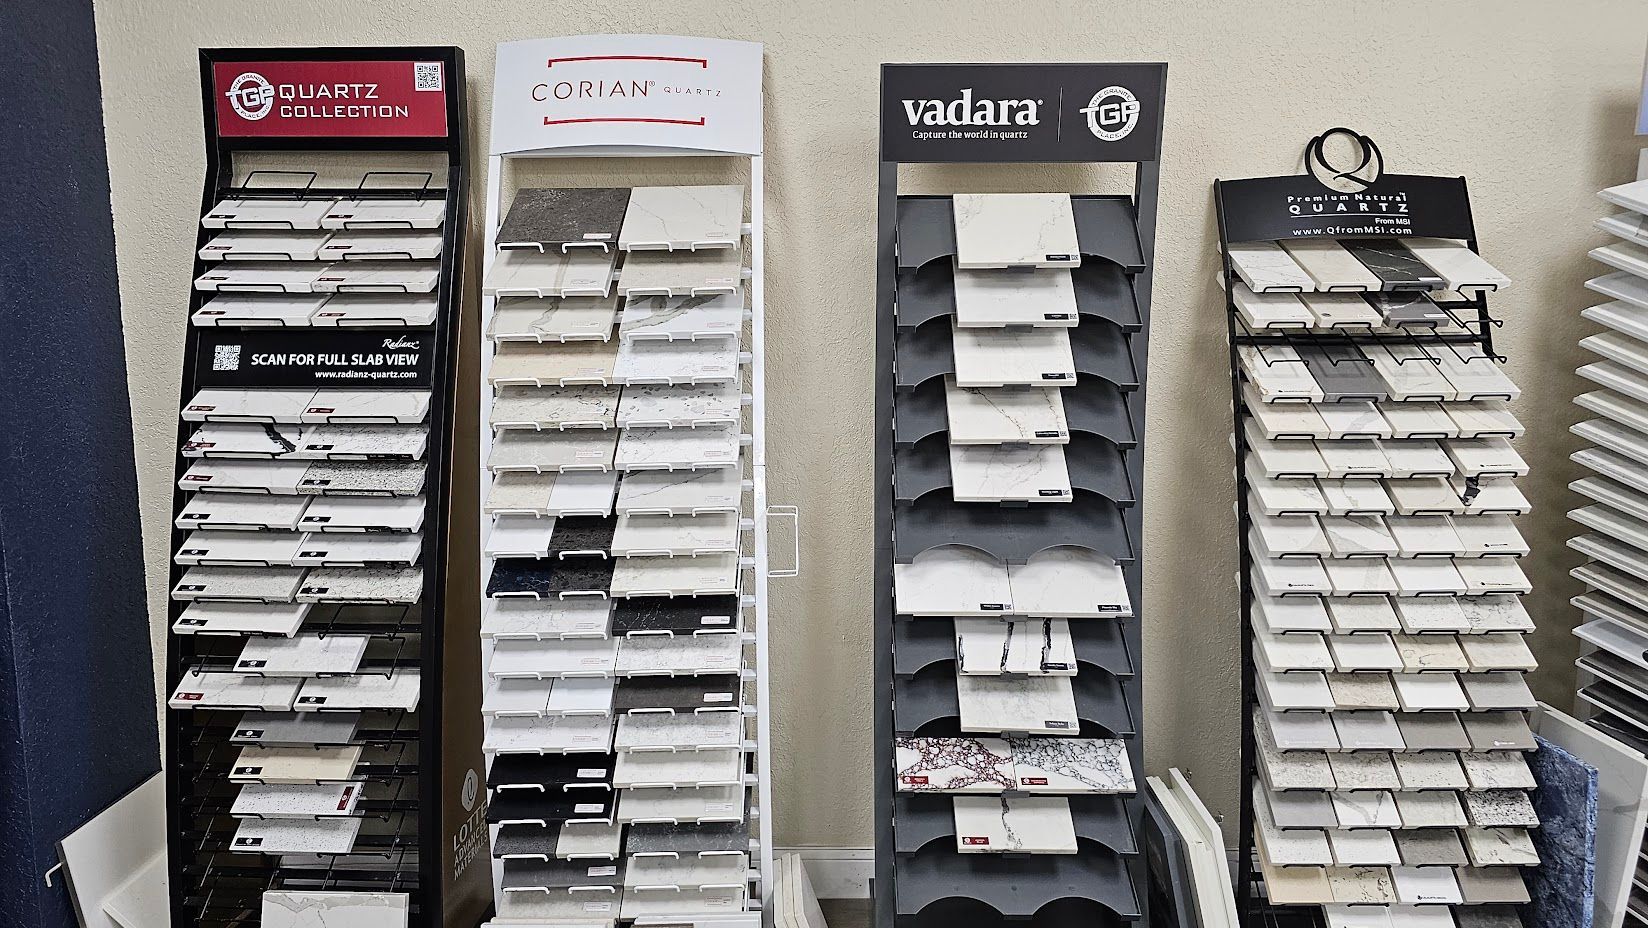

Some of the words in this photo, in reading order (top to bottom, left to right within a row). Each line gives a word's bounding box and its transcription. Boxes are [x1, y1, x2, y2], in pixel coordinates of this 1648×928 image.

[225, 84, 275, 109] TGP
[279, 83, 379, 102] QUARTZ
[663, 86, 721, 97] QUARTZ
[1104, 89, 1132, 101] GRANITE
[280, 105, 409, 118] COLLECTION
[1080, 100, 1140, 128] TGP
[912, 131, 947, 140] Capture
[948, 130, 963, 139] the
[964, 130, 989, 139] world
[989, 130, 999, 139] in
[999, 130, 1028, 140] quartz
[1287, 193, 1349, 203] Premium
[1289, 203, 1409, 215] QUARTZ
[1375, 217, 1395, 225] From
[1292, 226, 1413, 236] www.QfromMSI.com
[251, 353, 287, 366] SCAN
[288, 353, 315, 366] FOR
[317, 353, 349, 366] FULL
[350, 353, 384, 366] SLAB
[385, 353, 420, 366] VIEW
[315, 370, 418, 380] www.radianz-quartz.com
[453, 800, 488, 852] LOTTE
